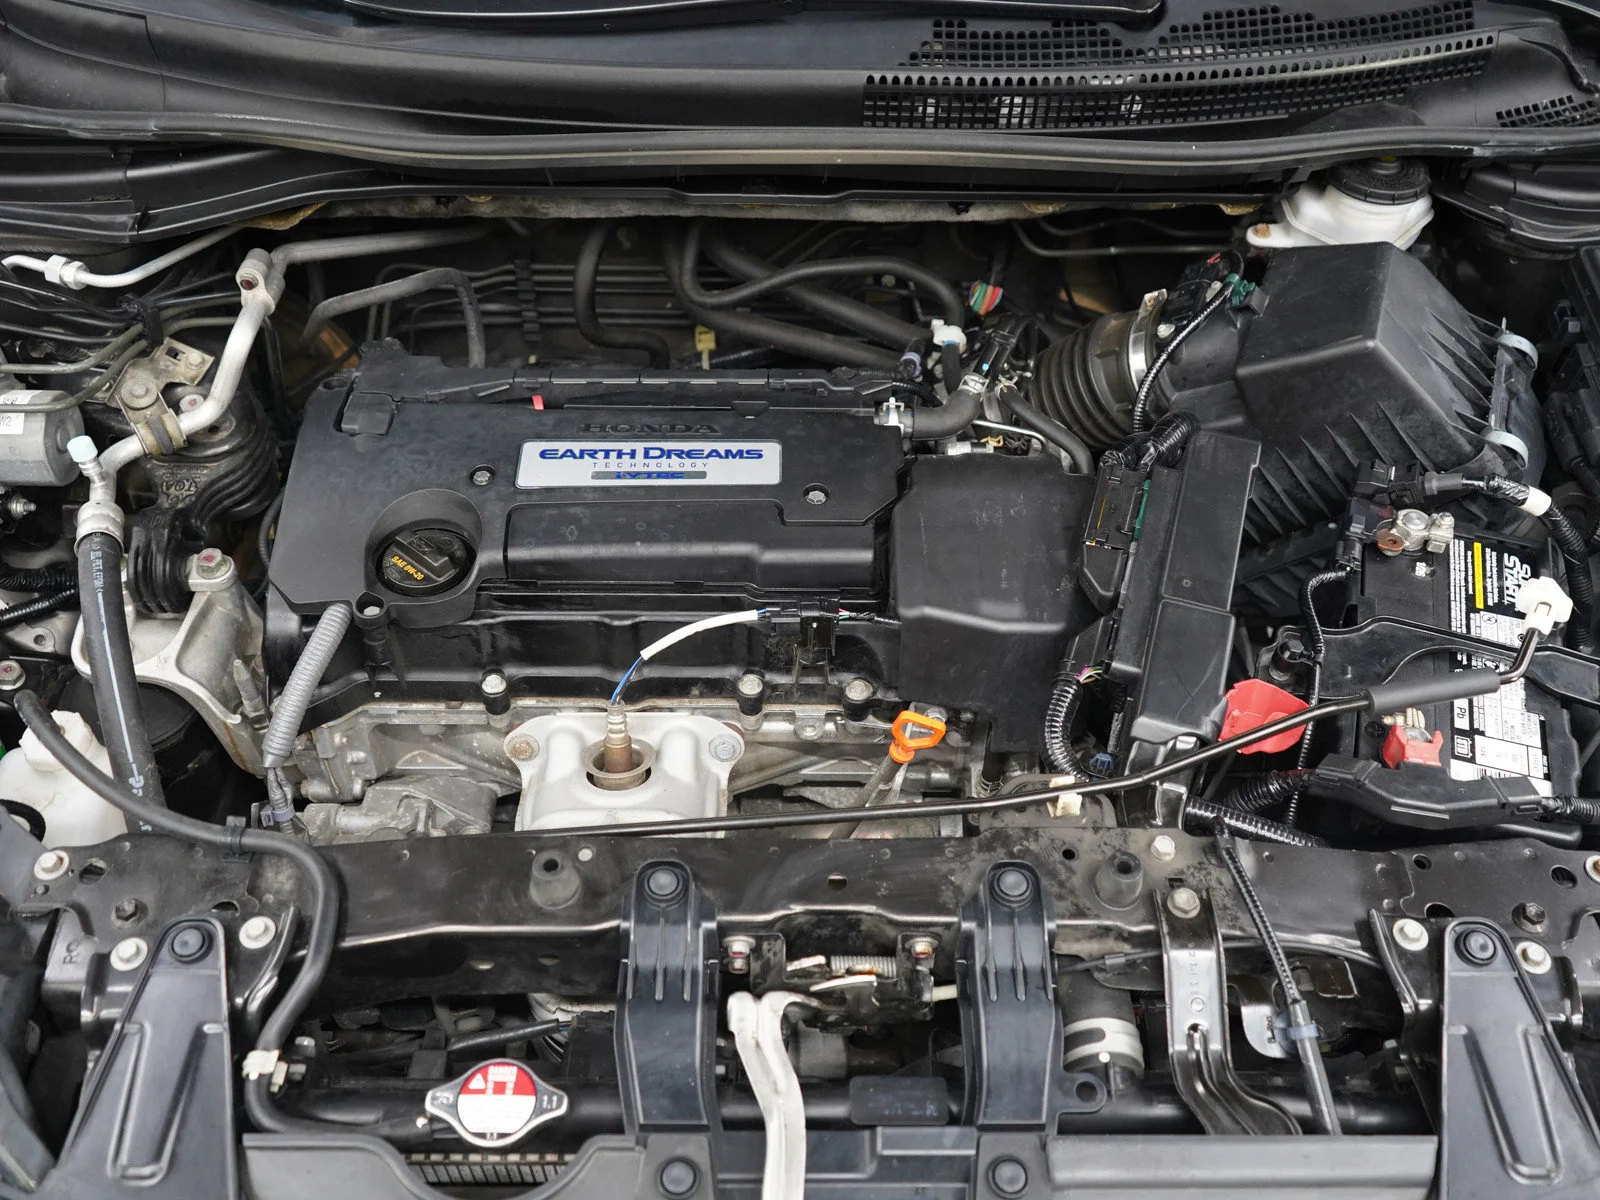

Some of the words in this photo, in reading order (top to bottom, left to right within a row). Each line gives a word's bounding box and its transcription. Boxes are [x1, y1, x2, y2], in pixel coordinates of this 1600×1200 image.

[579, 424, 722, 435] HONDA
[539, 448, 637, 460] EARTH
[643, 446, 764, 460] DREAMS
[391, 556, 407, 568] SAE
